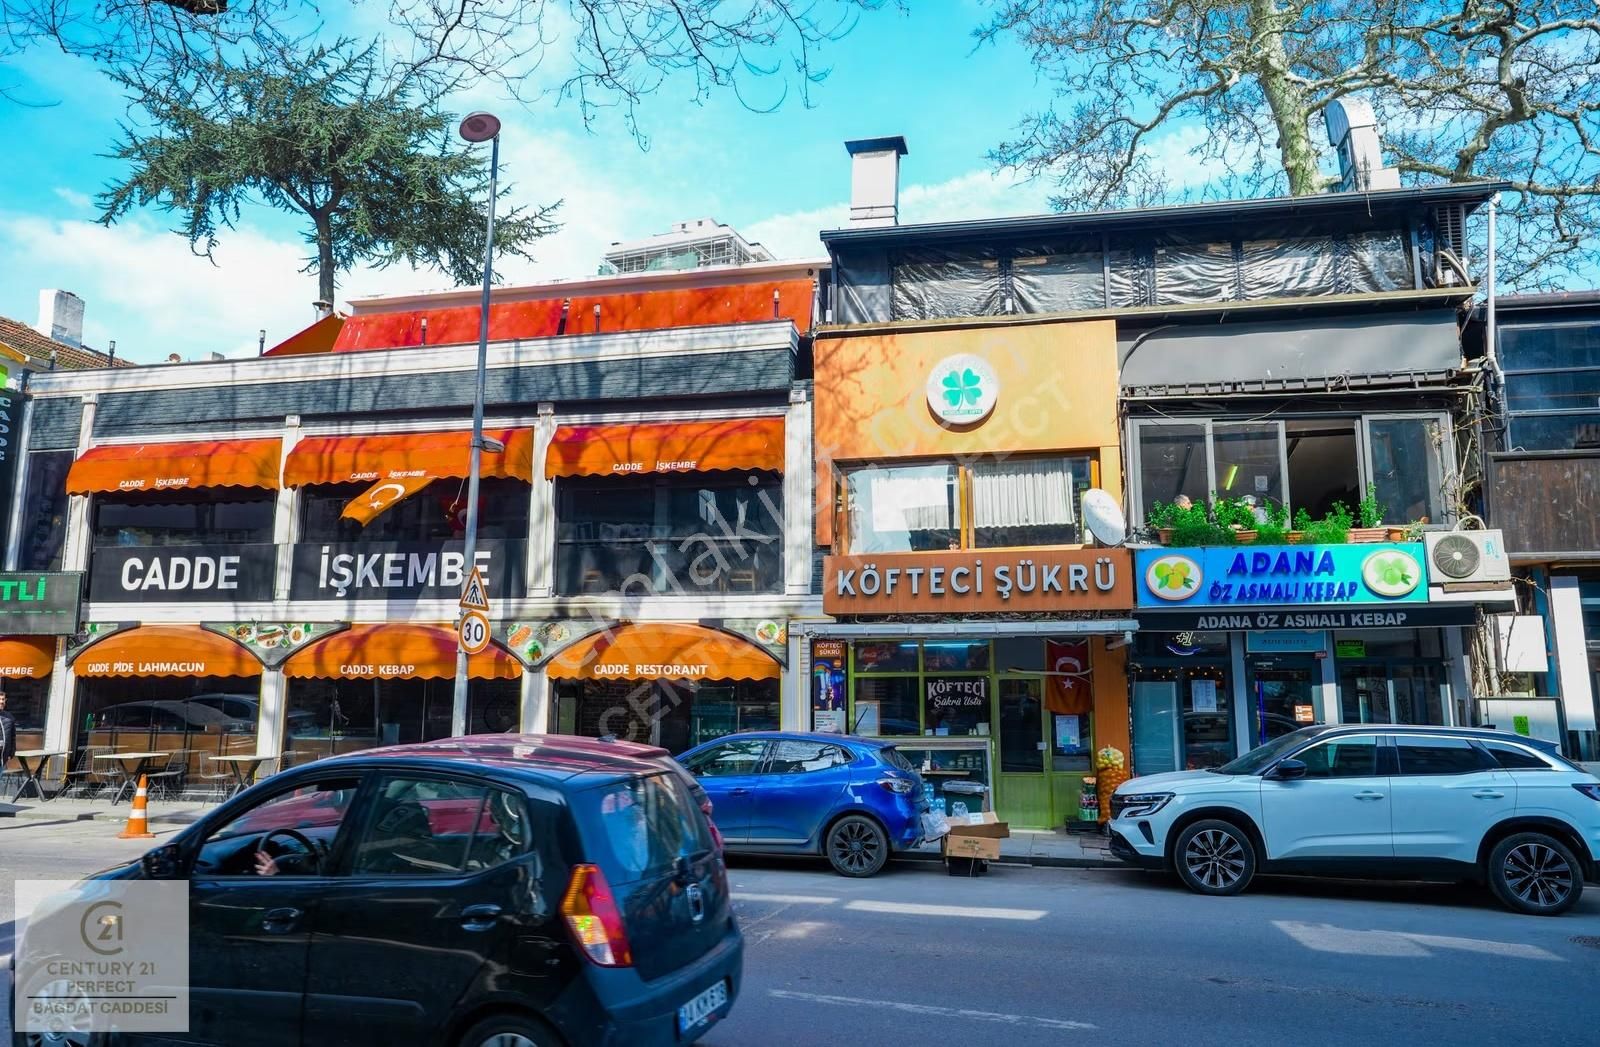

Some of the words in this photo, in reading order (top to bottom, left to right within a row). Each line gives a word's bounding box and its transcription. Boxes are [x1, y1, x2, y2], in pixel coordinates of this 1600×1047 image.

[350, 472, 378, 480] CADDE
[613, 462, 643, 472] CADDE
[119, 480, 145, 488] CADDE
[121, 556, 241, 591] CADDE
[319, 546, 492, 597] İŞKEMBE
[1228, 551, 1336, 577] ADANA
[837, 559, 983, 596] KÖFTECİ
[994, 557, 1116, 600] ŞÜKRÜ
[1209, 581, 1234, 601] ÖZ
[1236, 582, 1300, 601] ASMALI
[1302, 581, 1359, 602] KEBAP
[1197, 614, 1252, 629] ADANA
[1256, 612, 1279, 628] ÖZ
[1283, 613, 1346, 628] ASMALI
[1350, 612, 1408, 627] KEBAP
[463, 622, 484, 643] 30
[87, 663, 110, 673] CADDE
[113, 661, 134, 673] PİDE
[138, 662, 205, 673] LAHMACUN
[340, 665, 374, 675] CADDE
[378, 665, 415, 675] KEBAP
[594, 664, 629, 675] CADDE
[635, 664, 709, 676] RESTORANT
[927, 679, 985, 700] KÖFTECİ
